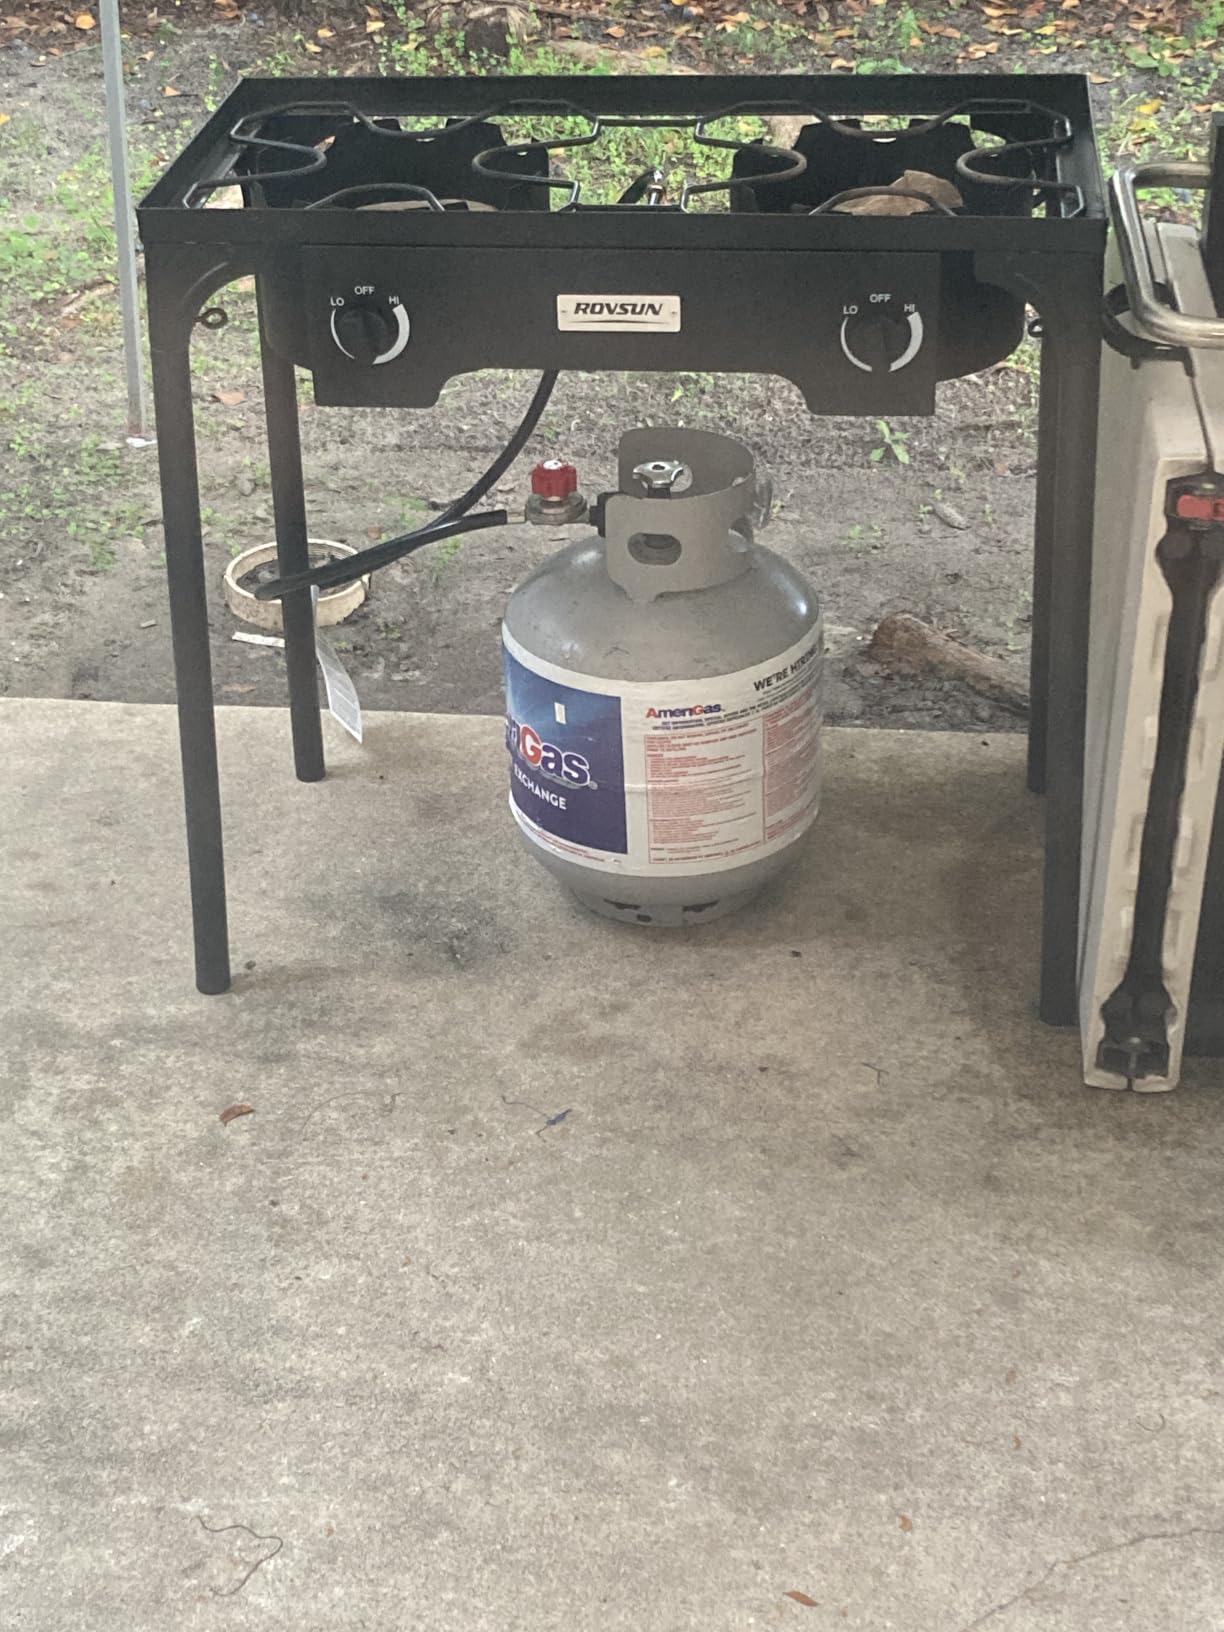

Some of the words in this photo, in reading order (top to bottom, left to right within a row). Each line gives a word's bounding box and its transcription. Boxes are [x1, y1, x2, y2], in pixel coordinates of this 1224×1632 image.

[330, 297, 345, 306] LO
[354, 286, 375, 295] OFF
[388, 295, 400, 305] HI
[843, 305, 858, 315] LO
[869, 293, 892, 303] OFF
[903, 303, 916, 313] HI
[573, 302, 663, 315] ROVSUN
[753, 668, 789, 691] WE'RE
[645, 704, 721, 719] AmeriGas
[514, 763, 568, 810] EXCHANGE
